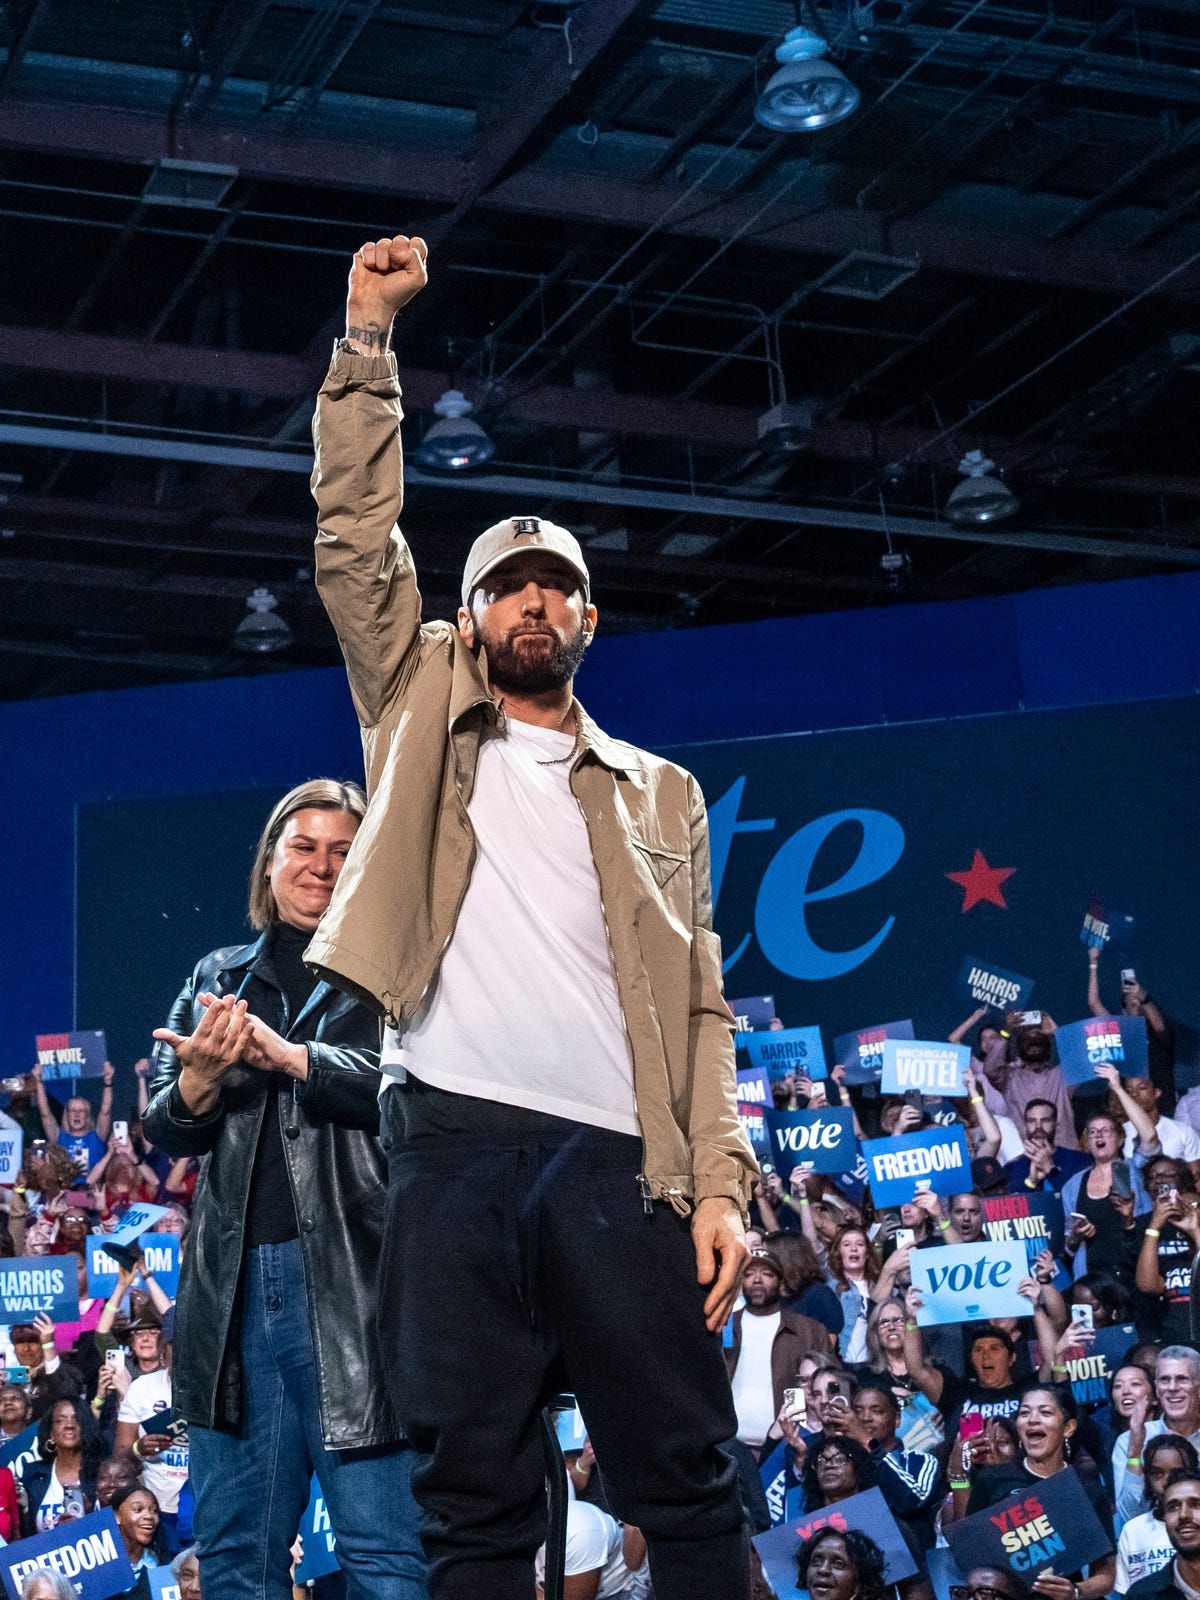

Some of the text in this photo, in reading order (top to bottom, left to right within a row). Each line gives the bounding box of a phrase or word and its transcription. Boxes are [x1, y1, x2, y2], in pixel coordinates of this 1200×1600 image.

[967, 967, 1022, 1002] HARRIS
[972, 986, 1008, 1010] WALZ
[1083, 1021, 1121, 1036] YES
[1086, 1034, 1122, 1051] SHE
[760, 1041, 807, 1060] HARRIS
[860, 1055, 883, 1068] CA
[1087, 1047, 1126, 1063] CAN
[895, 1058, 958, 1088] VOTE!
[775, 1118, 842, 1151] vote
[872, 1142, 963, 1182] FREEDOM
[988, 1215, 1051, 1241] WE VOTE,
[93, 1247, 173, 1275] FROM
[926, 1256, 1012, 1294] vote
[4, 1296, 55, 1312] WALZ
[1067, 1355, 1112, 1381] VOTE,
[990, 1497, 1045, 1533] YES
[1001, 1514, 1056, 1554] SHE
[9, 1529, 118, 1597] FREEDOM
[1008, 1532, 1067, 1572] CAN
